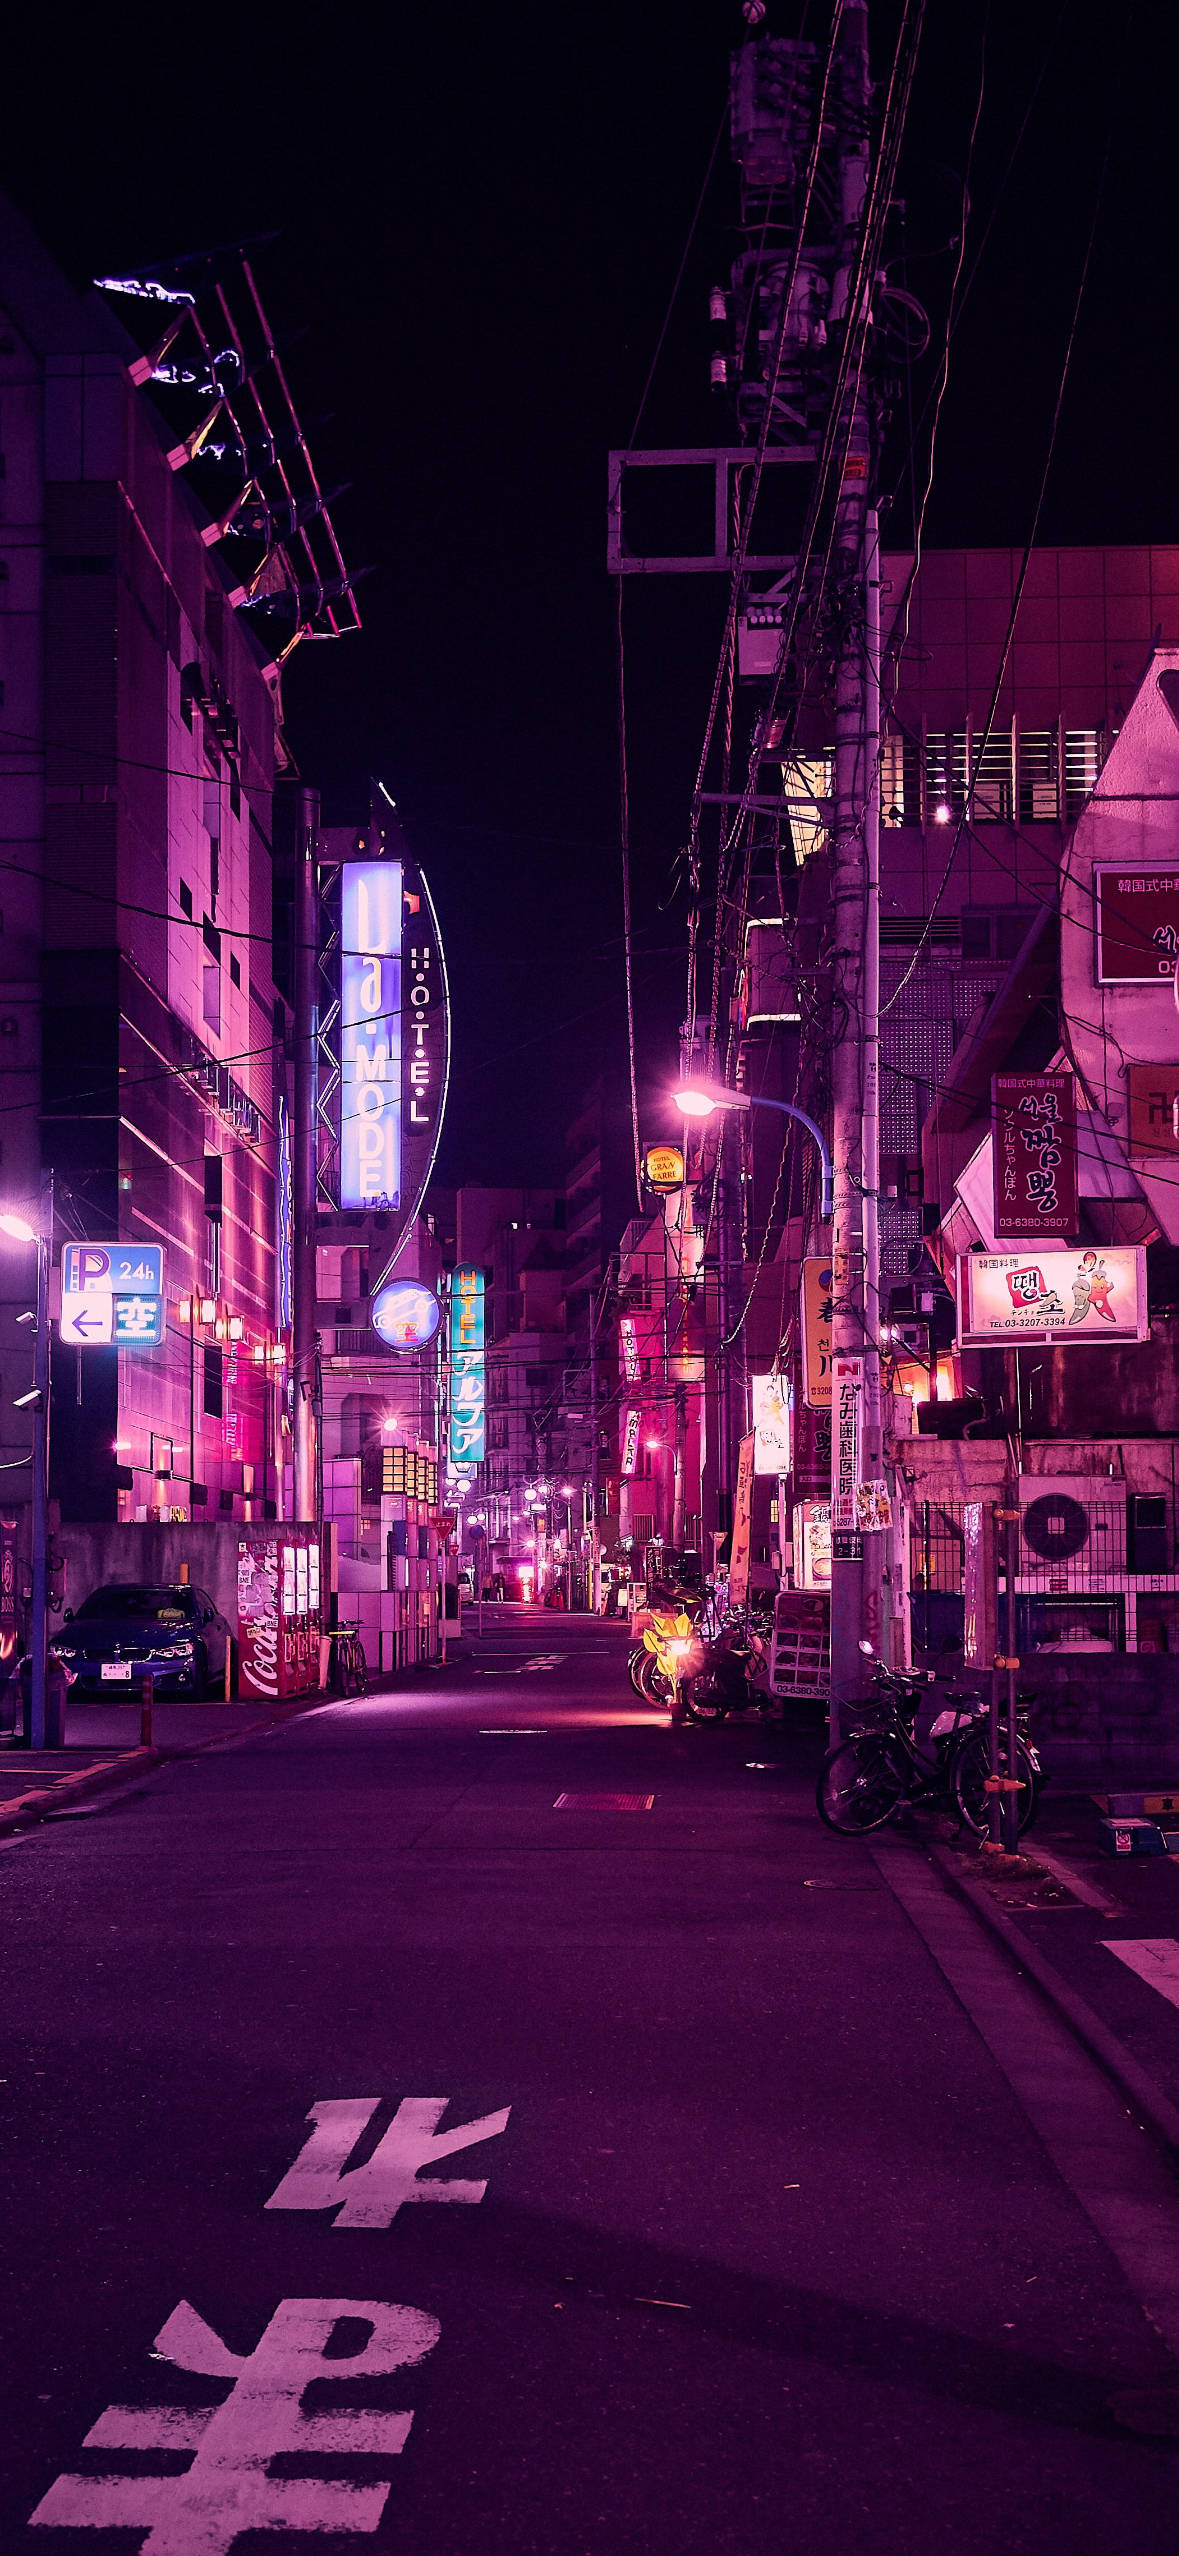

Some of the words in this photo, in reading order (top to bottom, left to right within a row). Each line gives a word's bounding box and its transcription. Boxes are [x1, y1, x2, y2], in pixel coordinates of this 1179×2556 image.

[999, 1218, 1069, 1227] 03-6380-3907
[120, 1262, 155, 1281] 24h
[978, 1258, 1019, 1269] 韓国料理
[116, 1296, 157, 1337] 空
[459, 1270, 477, 1344] HOTEL
